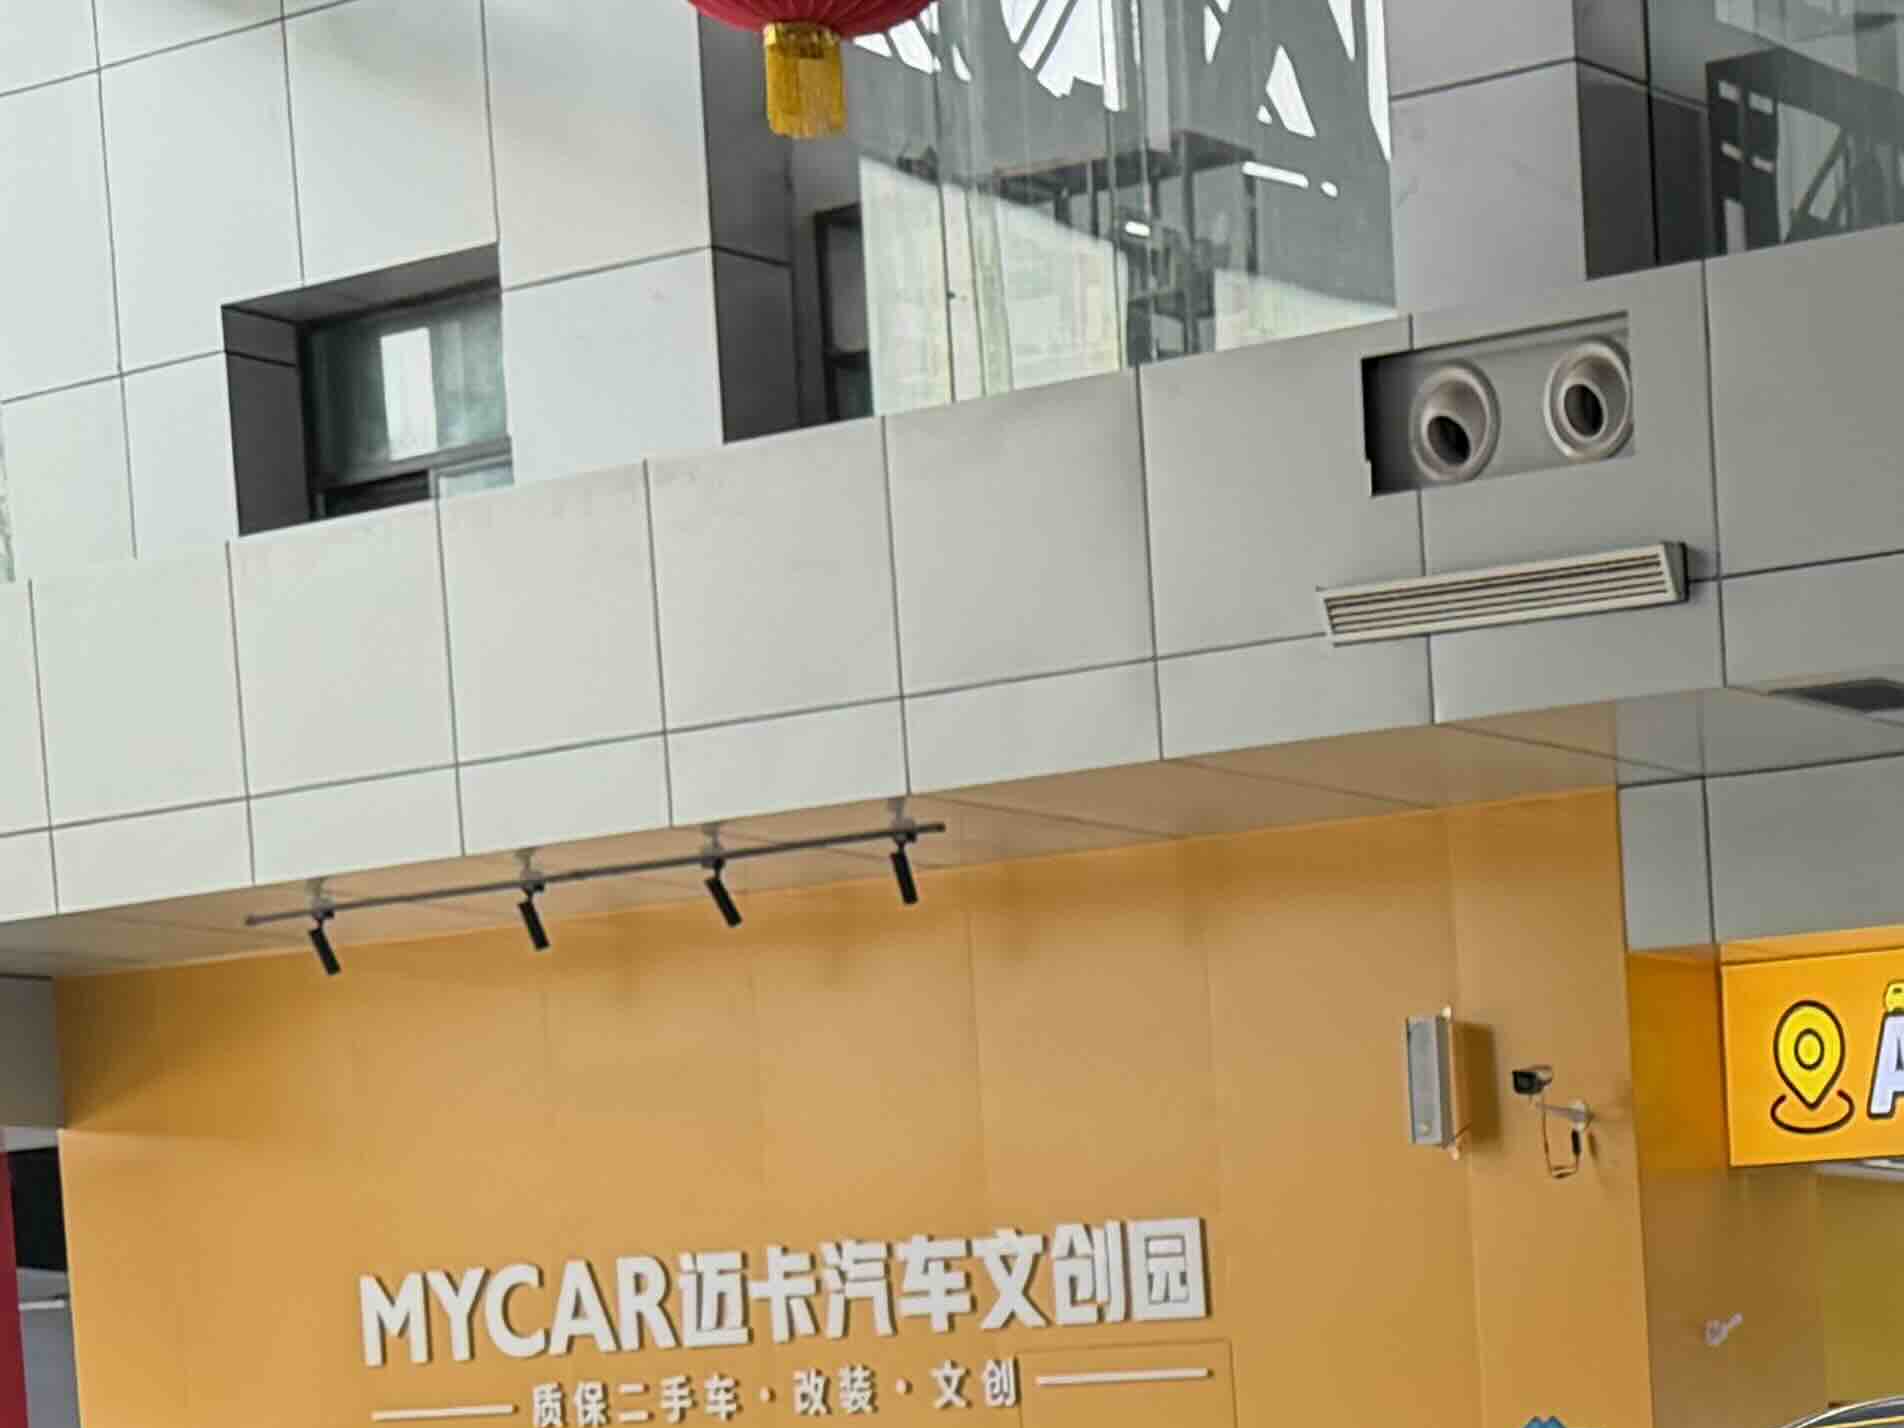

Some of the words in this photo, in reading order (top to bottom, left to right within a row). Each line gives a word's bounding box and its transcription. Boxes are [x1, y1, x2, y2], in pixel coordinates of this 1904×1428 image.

[358, 1217, 1208, 1367] MYCAR迈卡汽车文创园
